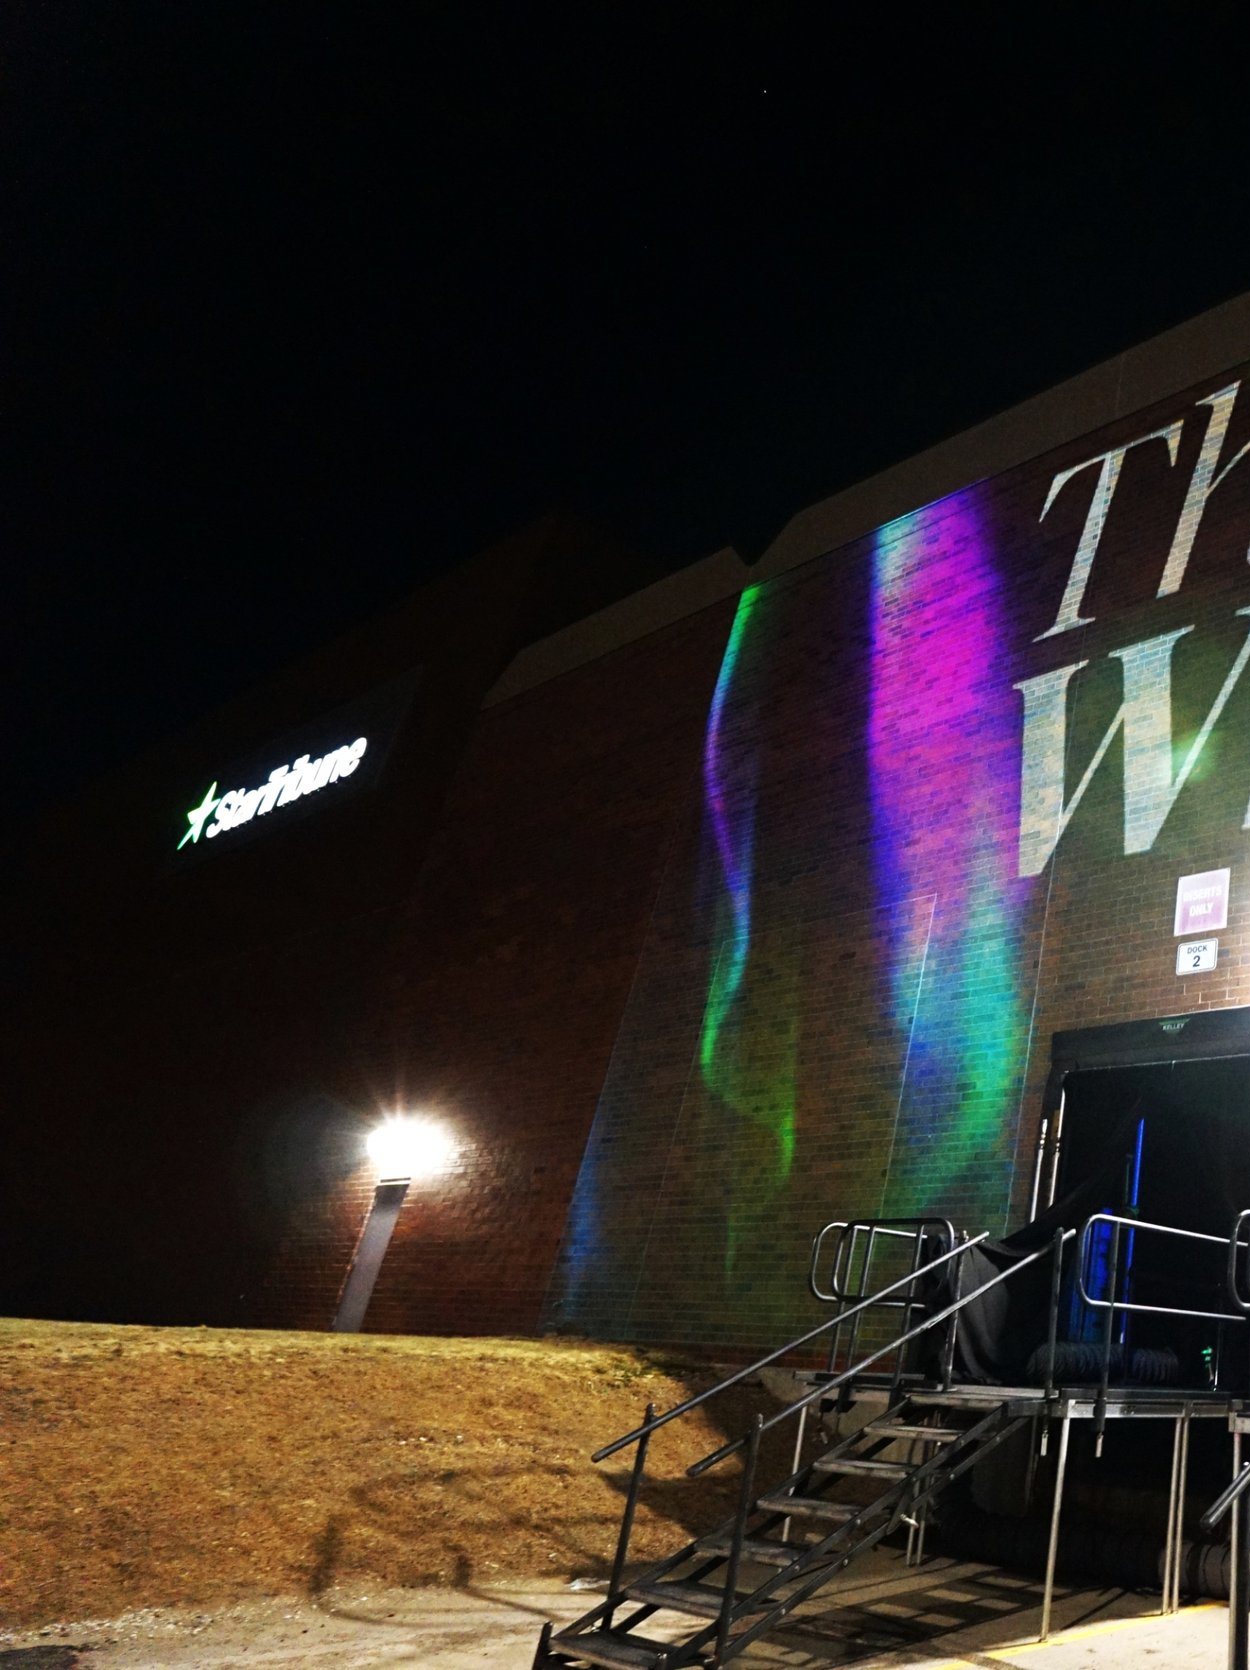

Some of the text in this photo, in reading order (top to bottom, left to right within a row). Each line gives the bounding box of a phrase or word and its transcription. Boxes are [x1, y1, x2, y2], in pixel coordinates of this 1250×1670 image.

[206, 737, 367, 838] StarTribune
[1189, 902, 1214, 917] ONLY
[1187, 944, 1208, 954] DOCK
[1192, 955, 1201, 968] 2
